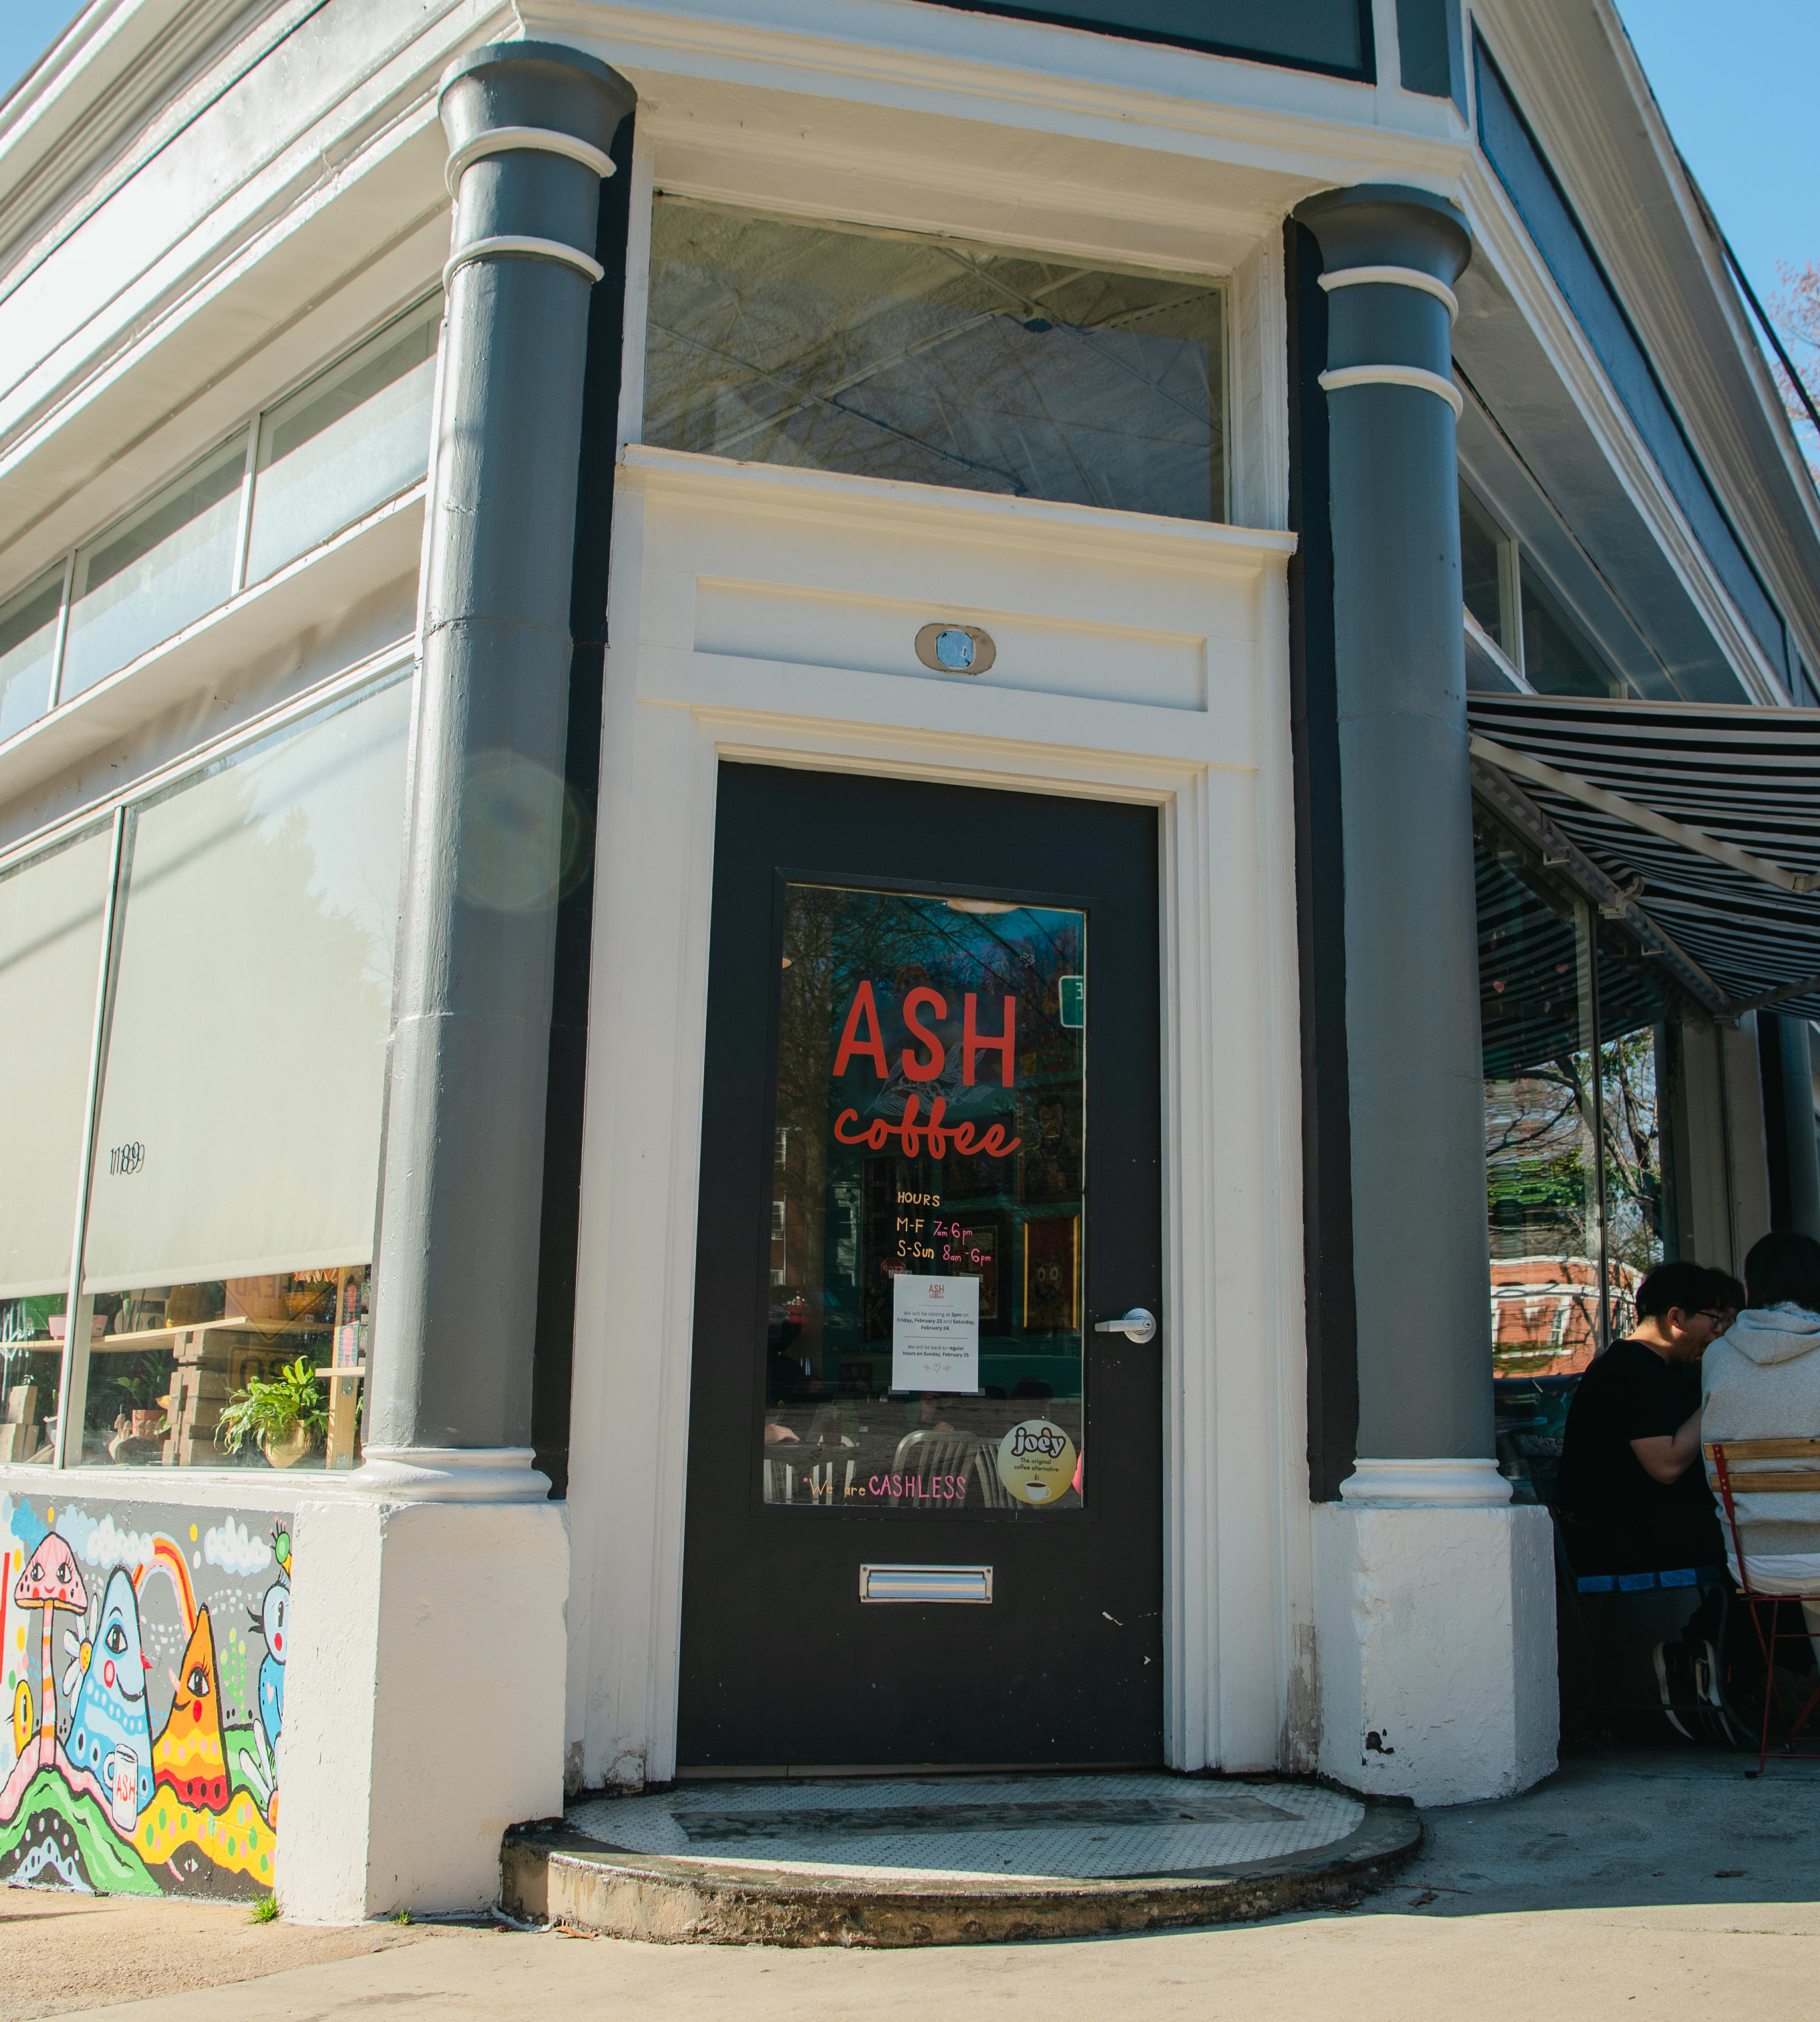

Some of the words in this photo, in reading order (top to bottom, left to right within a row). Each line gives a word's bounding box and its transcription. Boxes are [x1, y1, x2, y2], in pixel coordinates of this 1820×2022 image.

[833, 980, 1016, 1088] ASH
[834, 1094, 1021, 1160] coffee
[898, 1191, 940, 1206] HOURS
[897, 1217, 924, 1233] M-F
[897, 1240, 934, 1259] S-Sun
[929, 1284, 944, 1293] ASH
[1011, 1427, 1066, 1459] joey
[844, 1486, 866, 1498] are
[869, 1474, 965, 1500] CASHLESS
[116, 1774, 136, 1805] ASH
